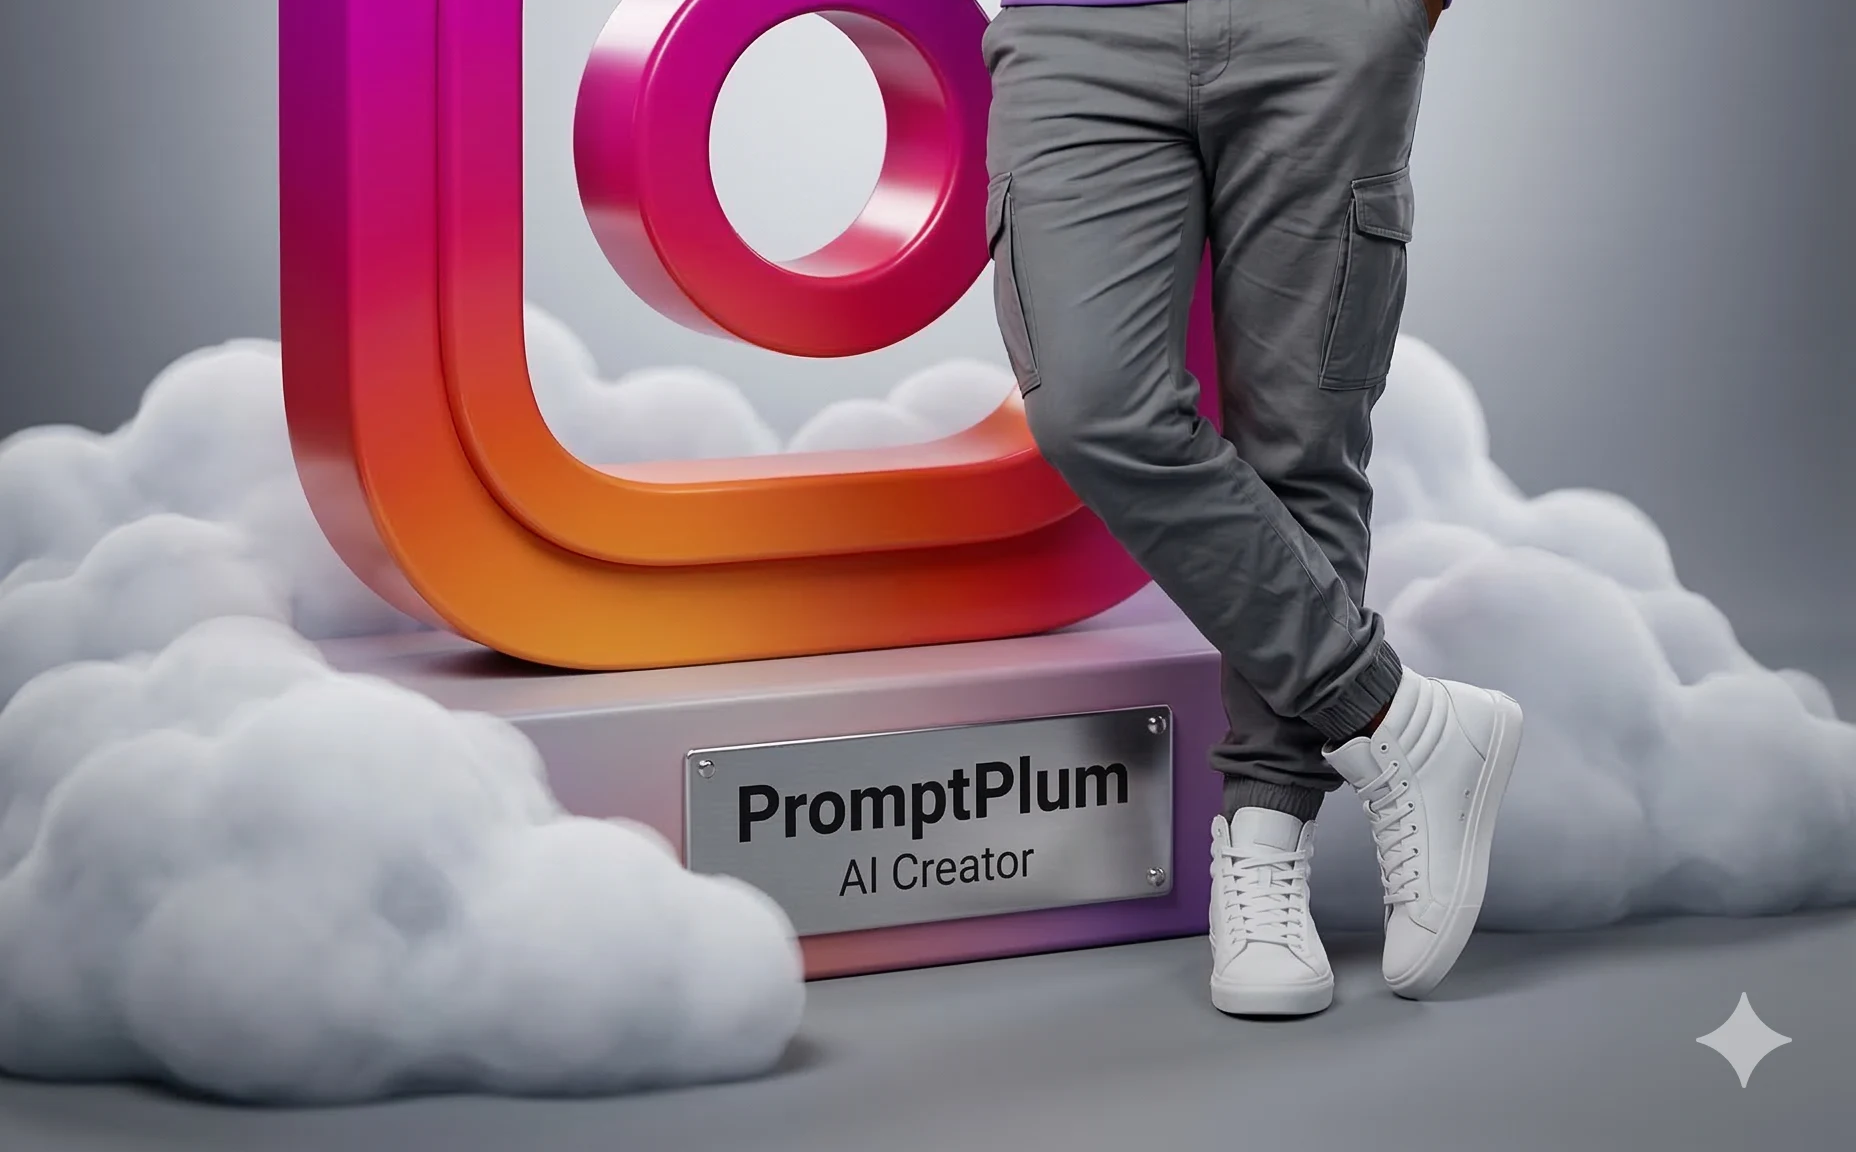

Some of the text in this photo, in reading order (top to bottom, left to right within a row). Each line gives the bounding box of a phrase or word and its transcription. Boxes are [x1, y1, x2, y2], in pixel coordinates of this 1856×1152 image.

[738, 755, 1129, 843] PromptPlum
[838, 847, 1035, 897] AI Creator
